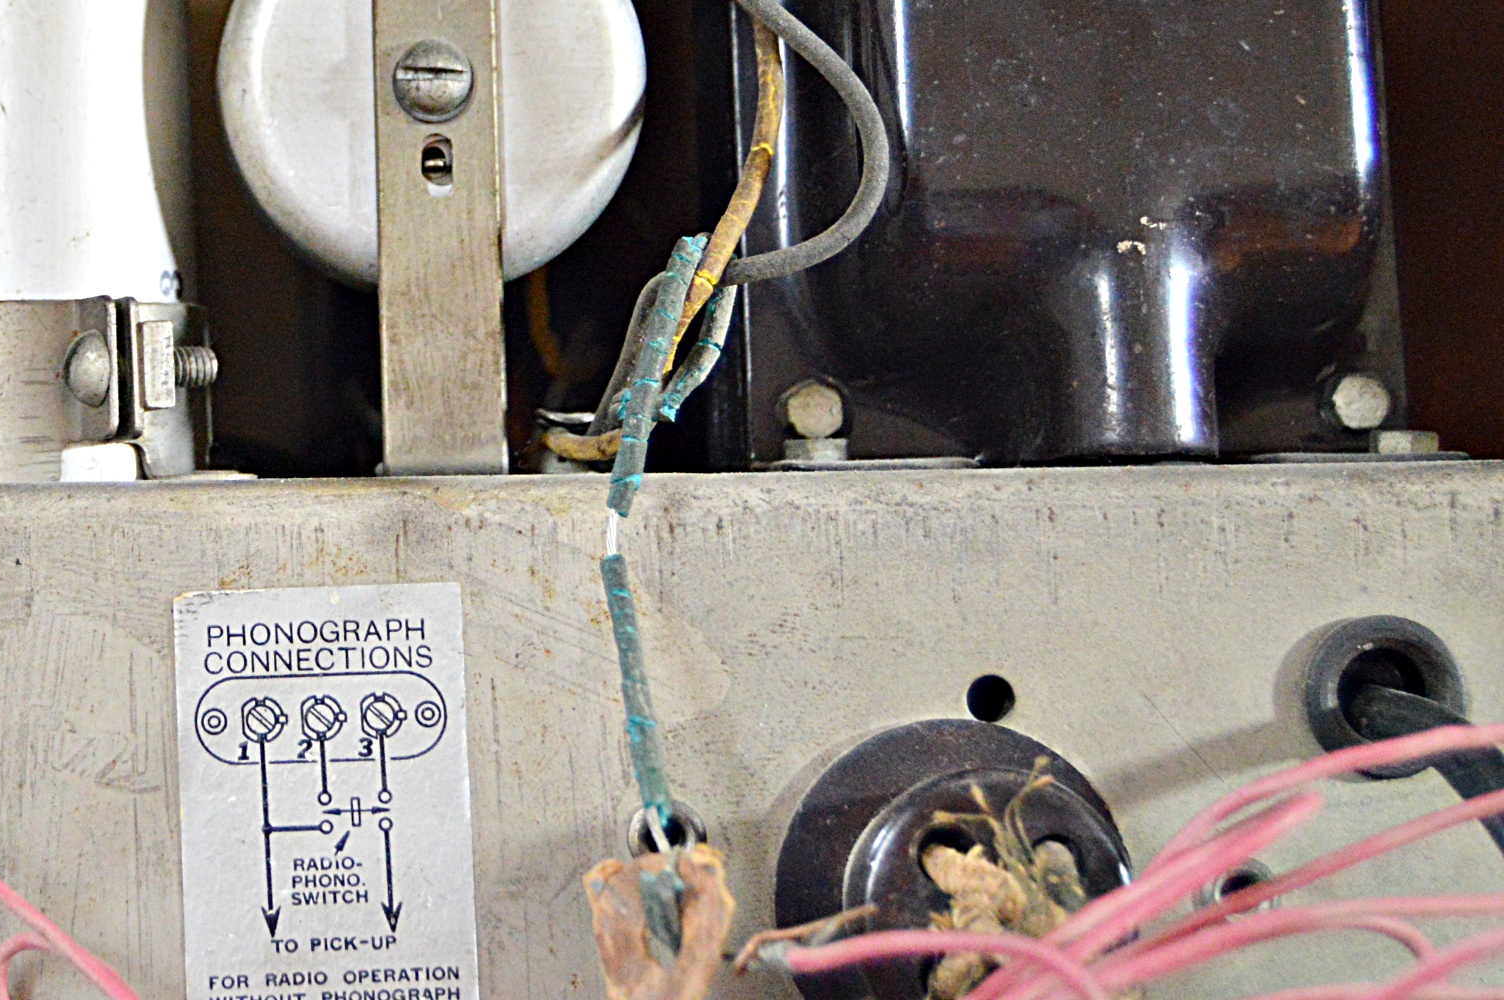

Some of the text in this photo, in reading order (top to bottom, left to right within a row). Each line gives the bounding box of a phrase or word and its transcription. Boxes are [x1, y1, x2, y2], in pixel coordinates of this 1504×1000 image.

[207, 618, 425, 647] PHONOGRAPH
[204, 645, 433, 675] CONNECTIONS
[238, 738, 374, 761] 1 2 3
[293, 857, 363, 873] RADIO-
[292, 874, 366, 889] PHONO.
[291, 890, 369, 905] SWITCH
[271, 935, 397, 953] TO PICK-UP
[209, 967, 460, 990] FOR RADIO OPERATION
[322, 987, 461, 1000] PHONOGRAPH
